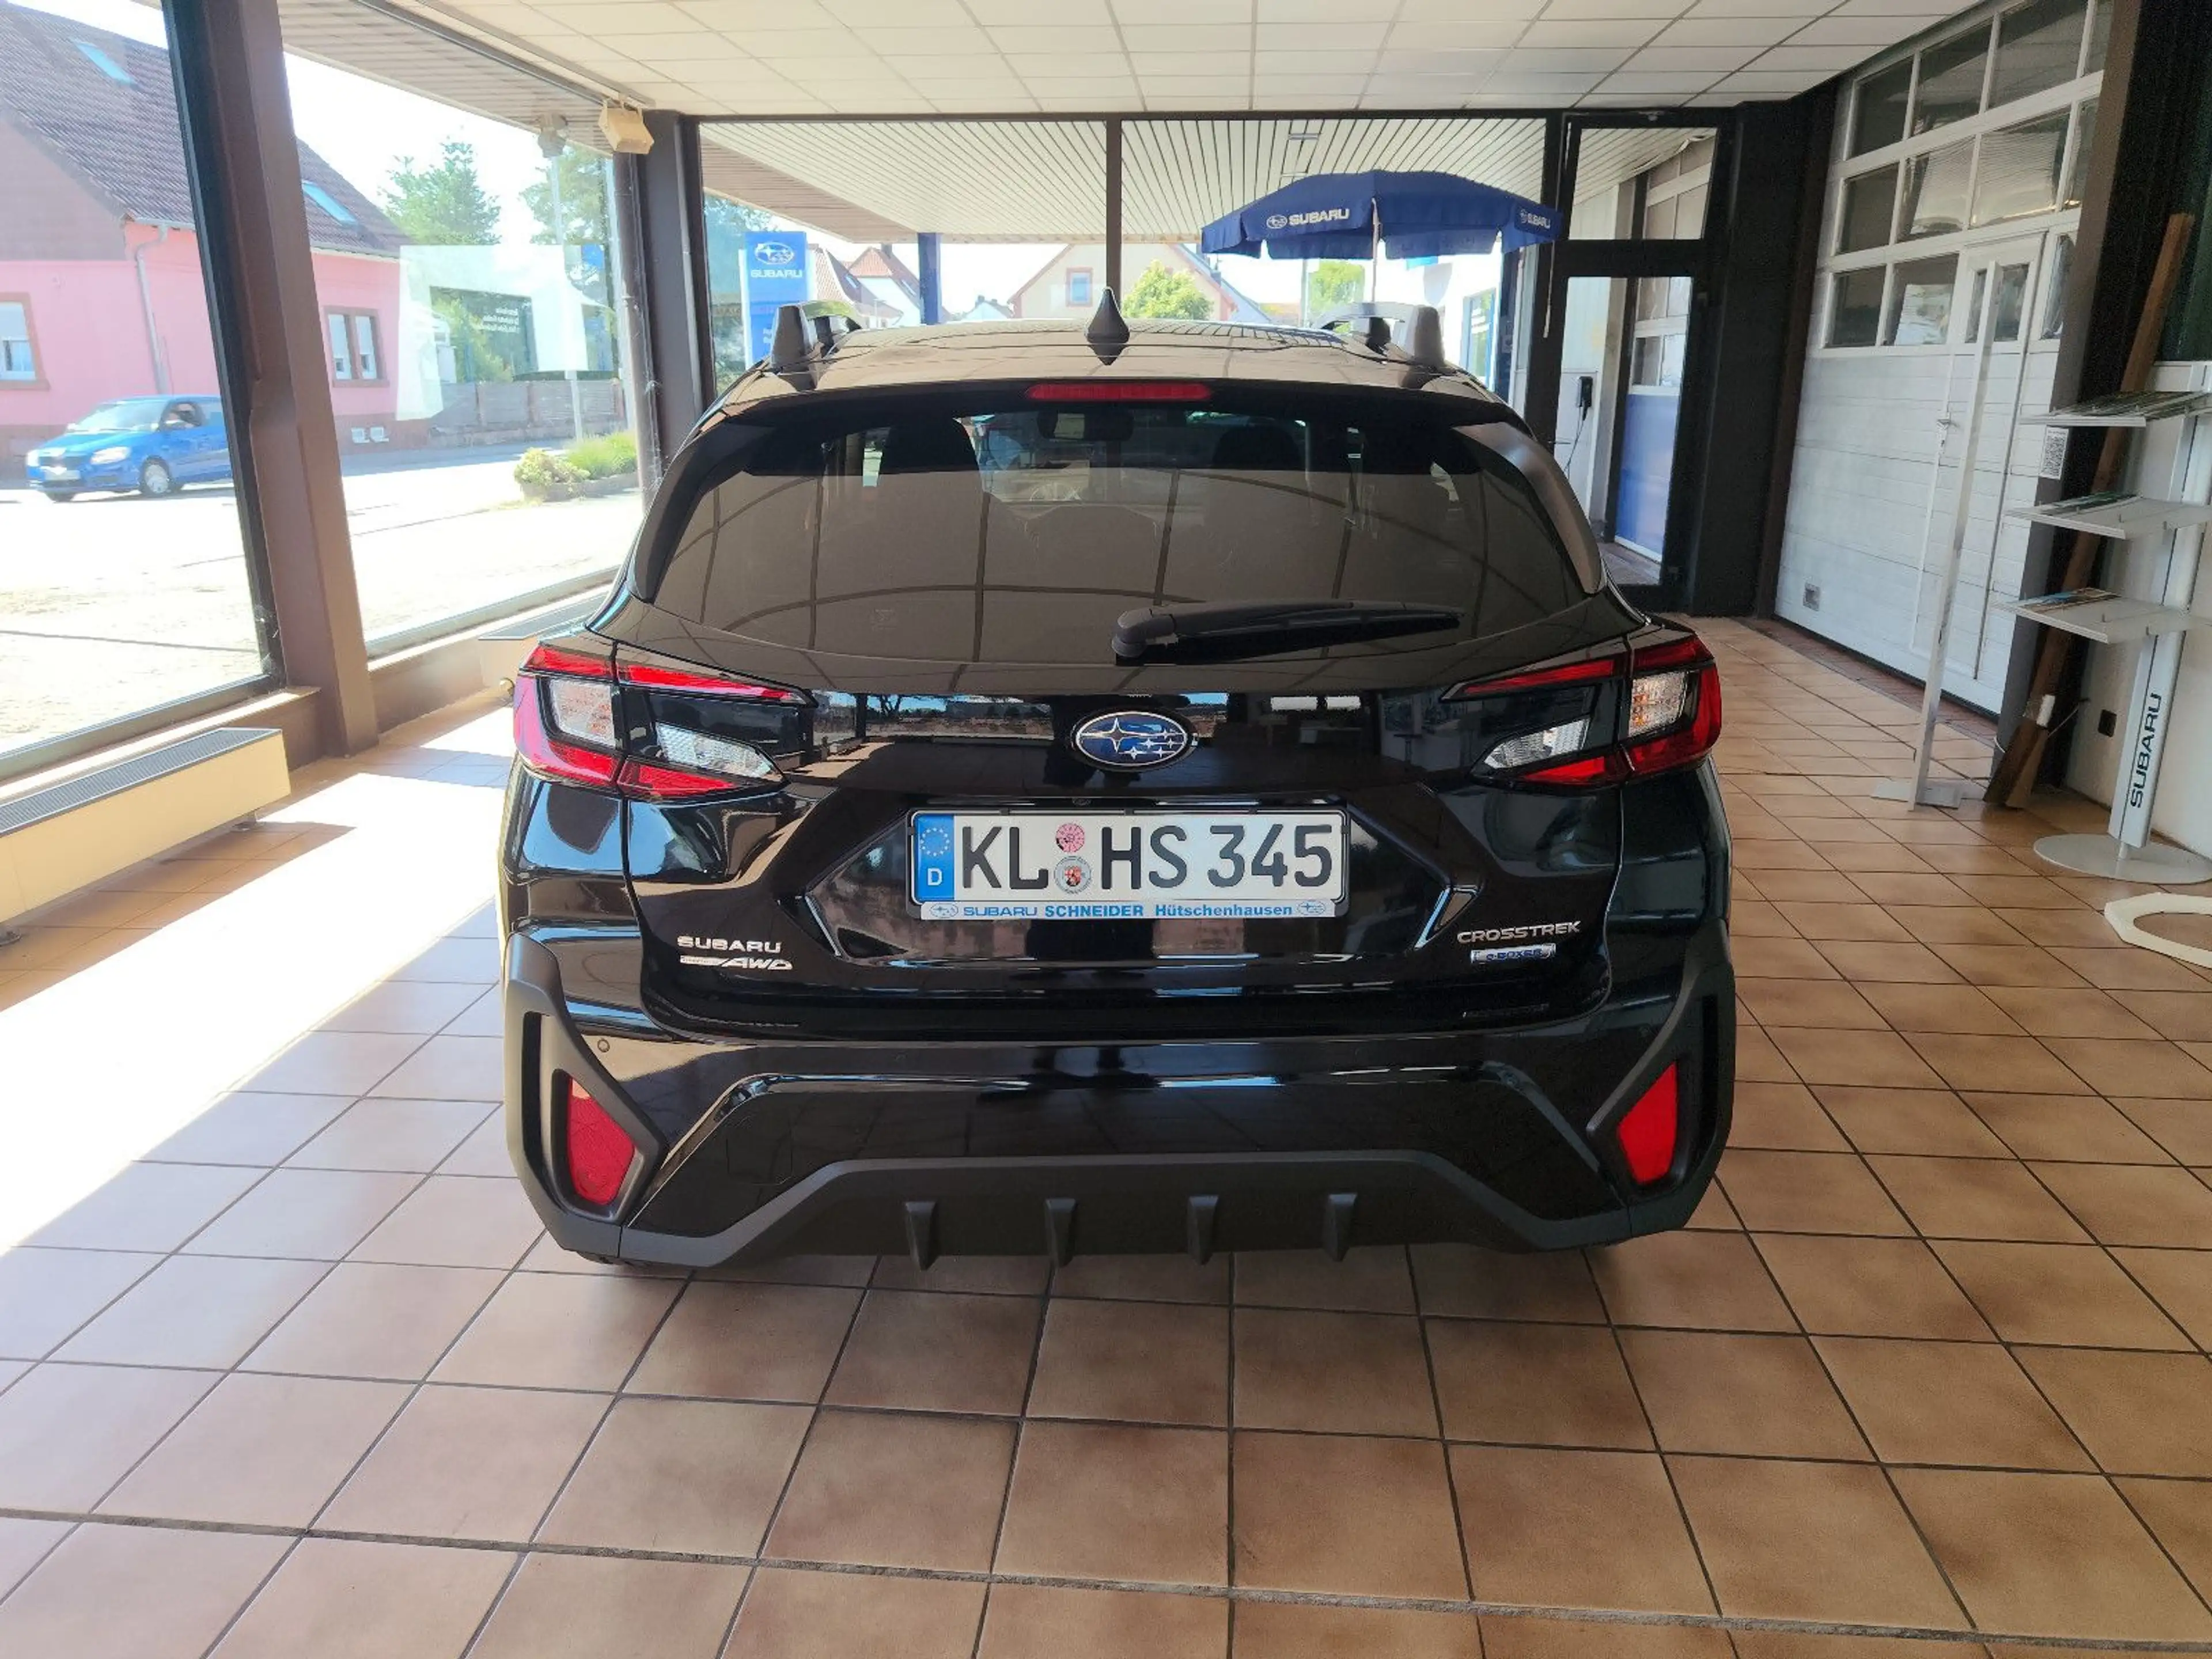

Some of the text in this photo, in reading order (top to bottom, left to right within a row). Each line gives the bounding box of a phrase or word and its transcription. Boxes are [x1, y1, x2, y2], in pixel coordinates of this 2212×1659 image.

[1289, 208, 1350, 226] SUBARU
[751, 269, 802, 278] SUBARU
[2130, 692, 2162, 808] SUBARU
[962, 826, 1049, 890] KL
[1101, 825, 1187, 890] HS
[1207, 824, 1332, 888] 345
[927, 868, 943, 886] D
[963, 904, 1293, 918] SUBARU SCHNEIDER Hütschenhausen
[1457, 921, 1581, 944] CROSSTREK
[677, 935, 781, 953] SUBARU
[721, 957, 793, 970] AWD
